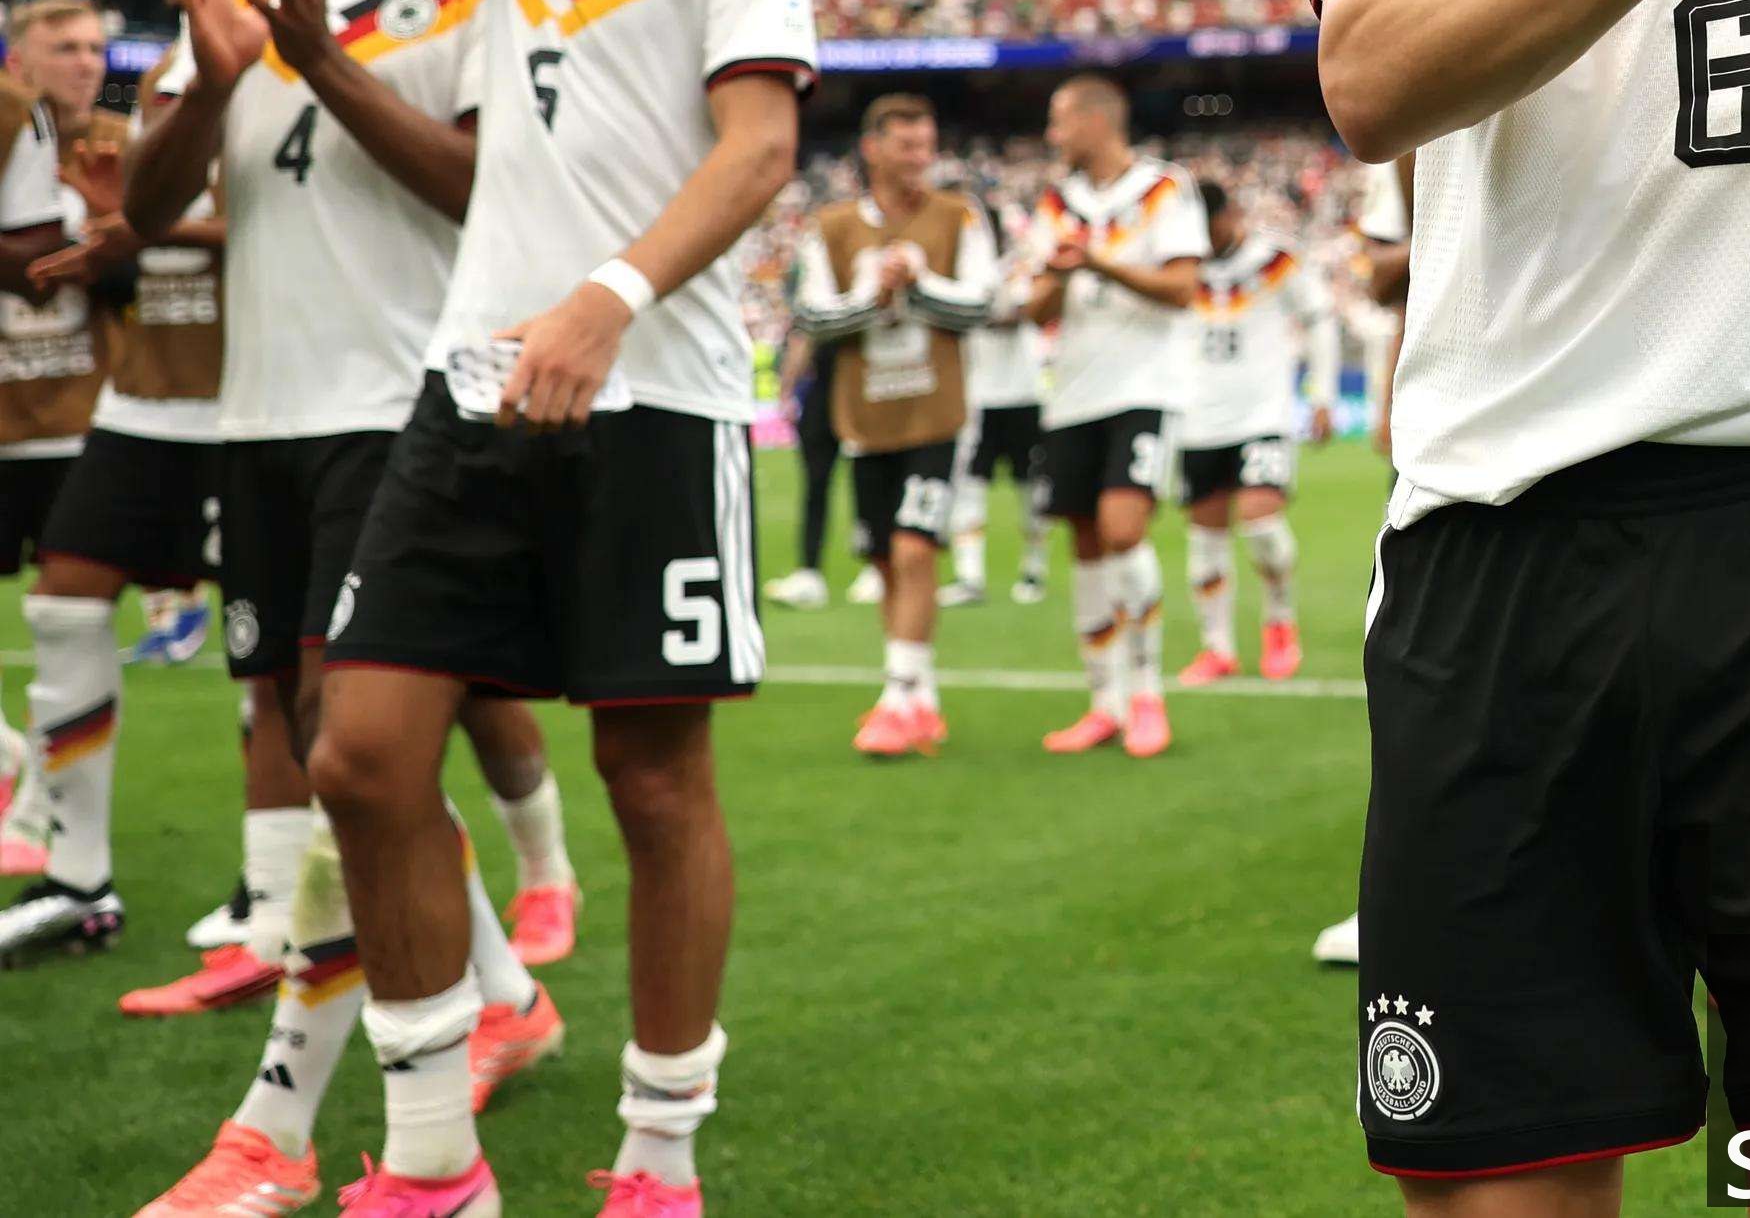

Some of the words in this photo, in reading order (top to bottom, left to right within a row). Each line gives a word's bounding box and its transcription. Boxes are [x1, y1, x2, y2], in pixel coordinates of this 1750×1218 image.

[273, 103, 317, 184] 4
[662, 557, 722, 666] 5
[1375, 1034, 1416, 1053] DEUTSCHER
[1375, 1080, 1427, 1108] FUSSBALL-BUND
